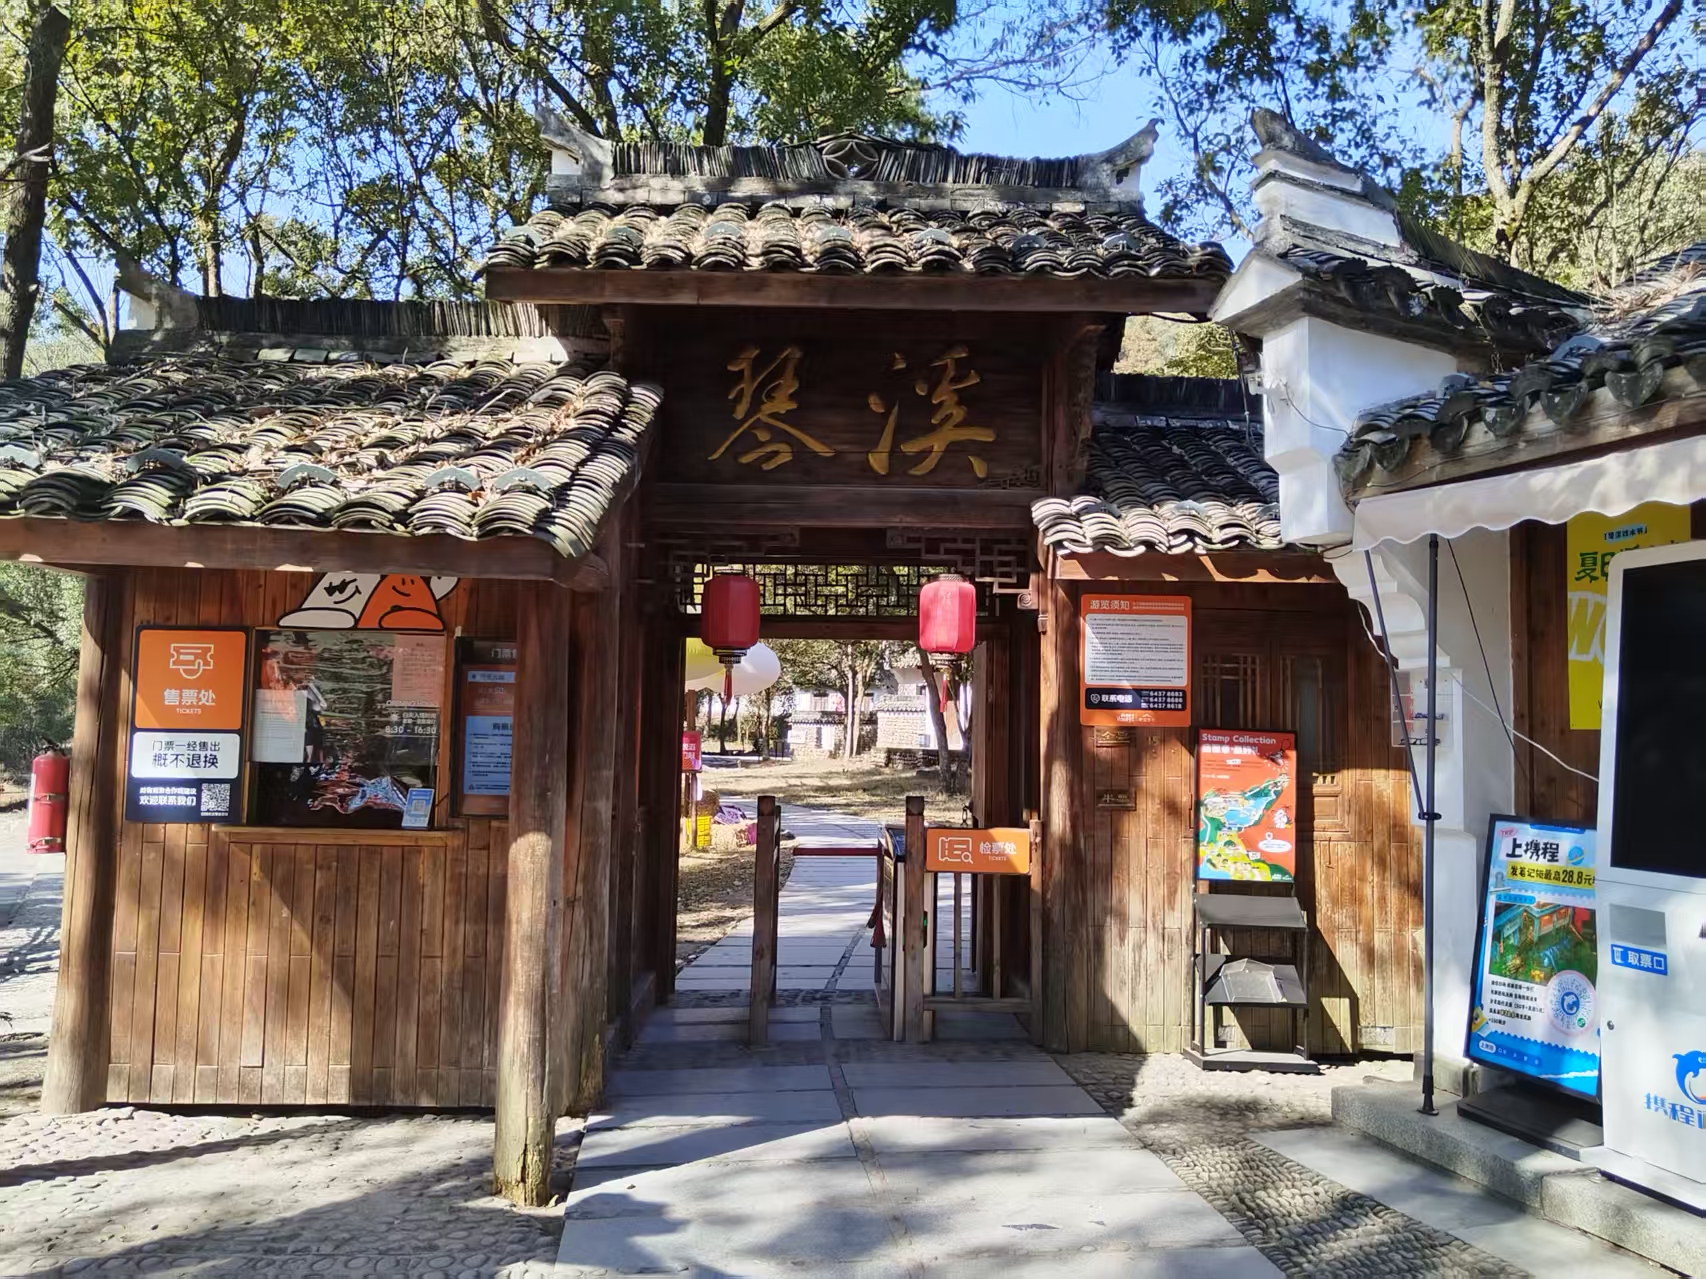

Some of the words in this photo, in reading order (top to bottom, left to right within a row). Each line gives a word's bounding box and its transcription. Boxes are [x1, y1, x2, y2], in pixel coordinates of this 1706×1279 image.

[1090, 599, 1130, 610] 游览须知
[164, 688, 217, 706] 售票处
[1101, 694, 1133, 703] 联系电话
[385, 725, 404, 734] 8:30
[414, 726, 436, 734] 16:30
[1202, 733, 1230, 743] Stamp
[1232, 735, 1277, 745] Collection
[152, 741, 220, 752] 门票一经售出
[152, 753, 219, 769] 概不退换
[139, 795, 197, 806] 欢迎联系我们
[979, 842, 1017, 855] 检票处
[1506, 837, 1560, 863] 上携程
[1627, 950, 1665, 970] 取票口
